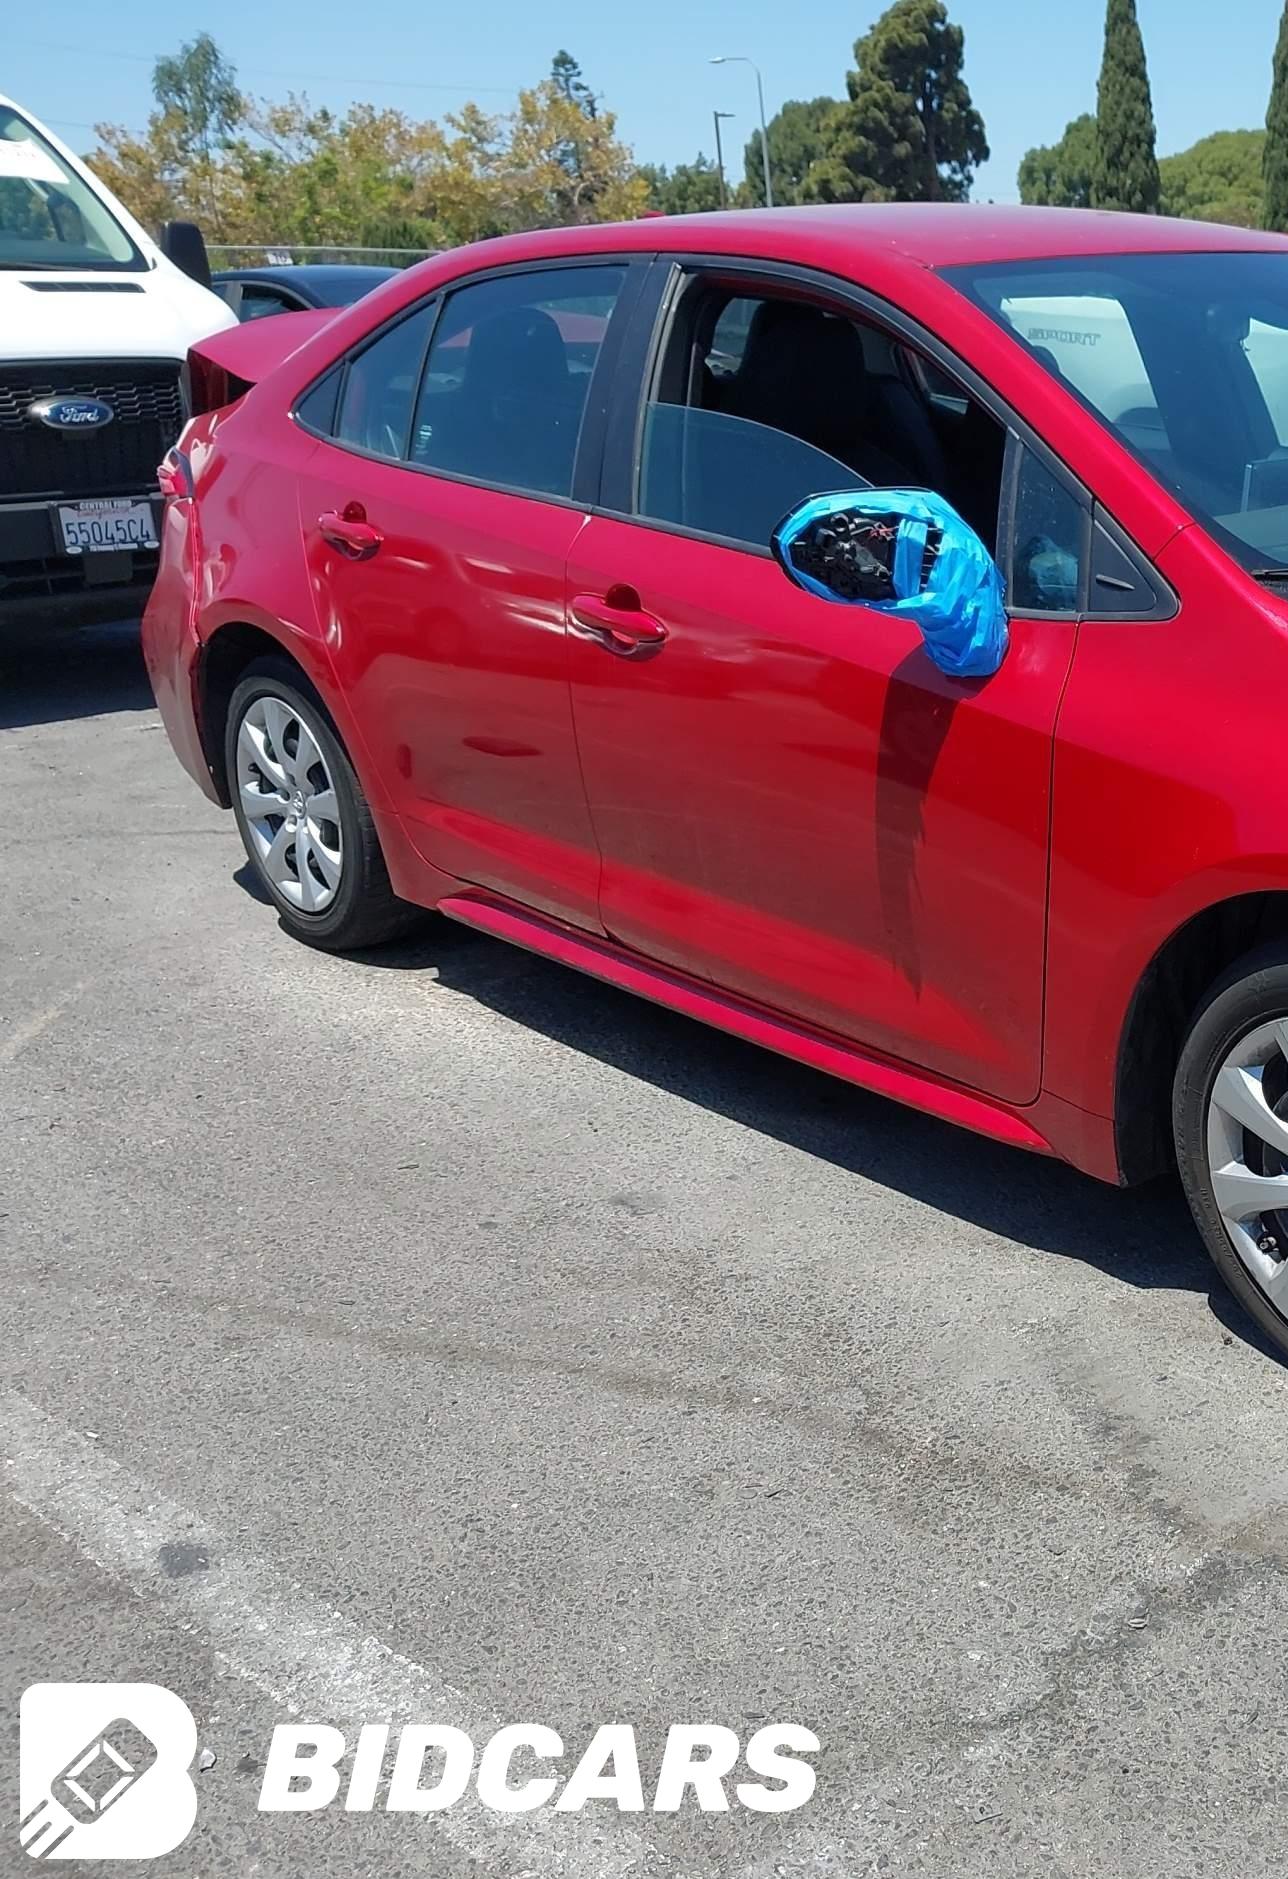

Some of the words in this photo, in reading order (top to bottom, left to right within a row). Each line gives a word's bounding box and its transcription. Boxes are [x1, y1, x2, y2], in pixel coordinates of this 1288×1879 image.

[1027, 327, 1101, 346] SPORT
[60, 405, 99, 423] Ford
[65, 518, 150, 546] 55045C4
